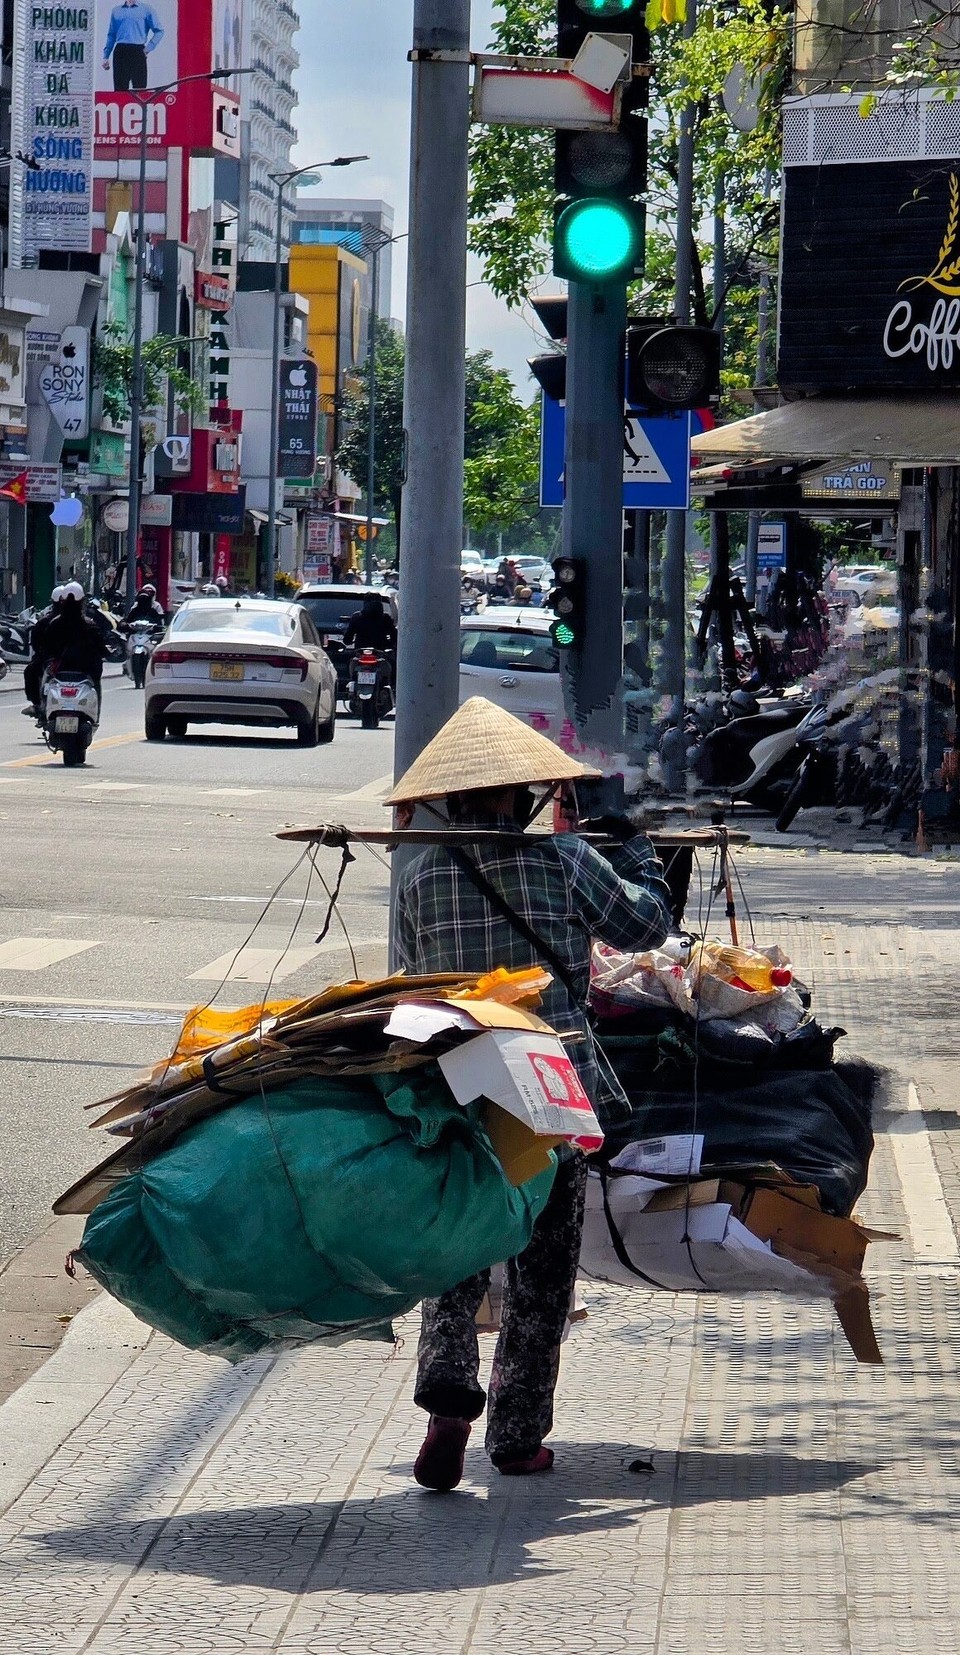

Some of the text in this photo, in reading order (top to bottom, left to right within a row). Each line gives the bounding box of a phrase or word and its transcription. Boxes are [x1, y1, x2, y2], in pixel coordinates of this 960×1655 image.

[34, 36, 84, 61] KHÁM
[35, 106, 80, 127] KHOA
[94, 103, 166, 135] men
[26, 170, 86, 193] HƯƠNG
[883, 298, 960, 371] Coff
[53, 365, 85, 378] RON
[43, 378, 84, 391] SONY
[285, 401, 310, 413] THÁI
[63, 418, 82, 432] 47
[289, 438, 304, 449] 65
[823, 473, 887, 490] TRẢ GÓP
